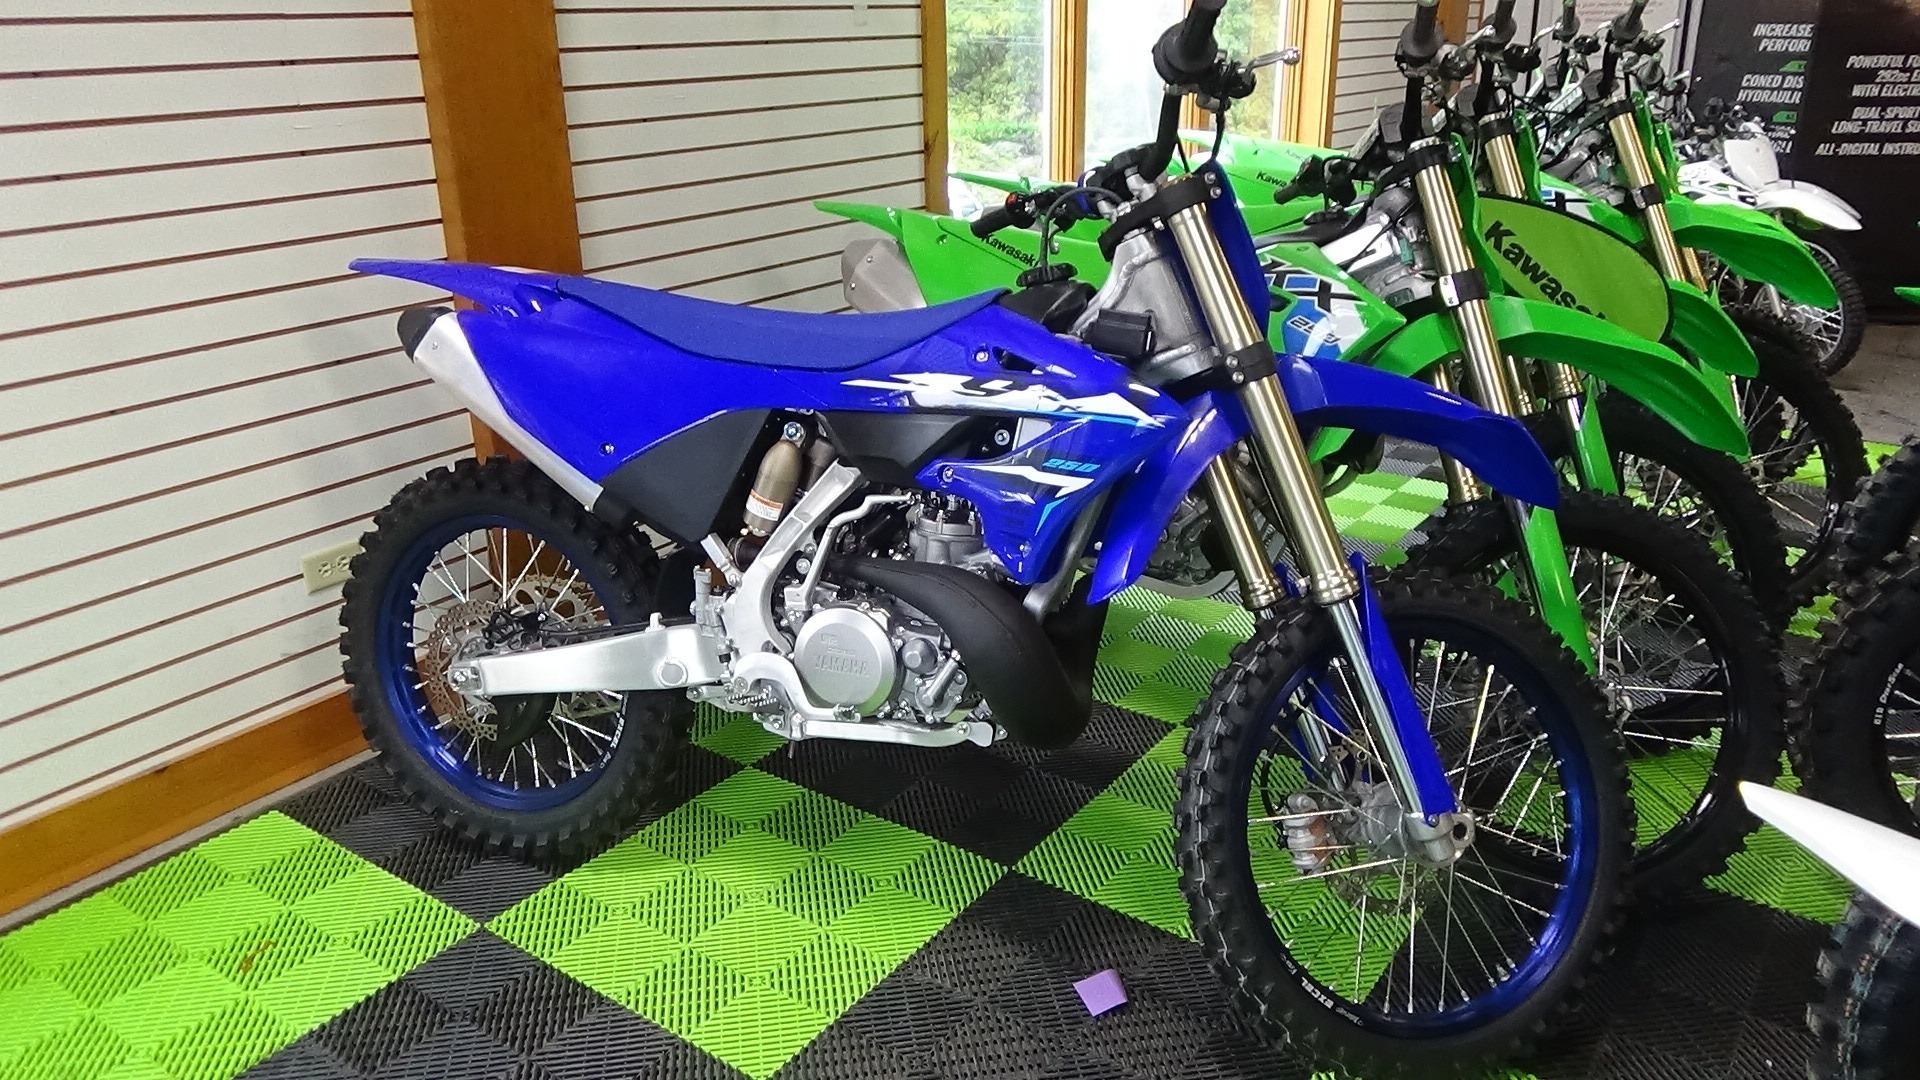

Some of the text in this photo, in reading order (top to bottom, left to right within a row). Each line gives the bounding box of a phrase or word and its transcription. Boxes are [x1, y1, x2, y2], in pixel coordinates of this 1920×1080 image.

[1758, 38, 1812, 52] PERFOR
[1845, 55, 1905, 69] POWERFUL
[1741, 74, 1783, 88] CONED
[1852, 84, 1881, 97] WITH
[1851, 106, 1920, 119] DUAL-SPORT
[1831, 120, 1904, 134] LONG-TRAVEL
[1815, 142, 1880, 155] ALL-DIGITAL
[1256, 170, 1288, 188] Kawa
[1484, 219, 1606, 320] Kawas
[1042, 458, 1101, 473] 250
[1301, 976, 1335, 1010] EXCEL
